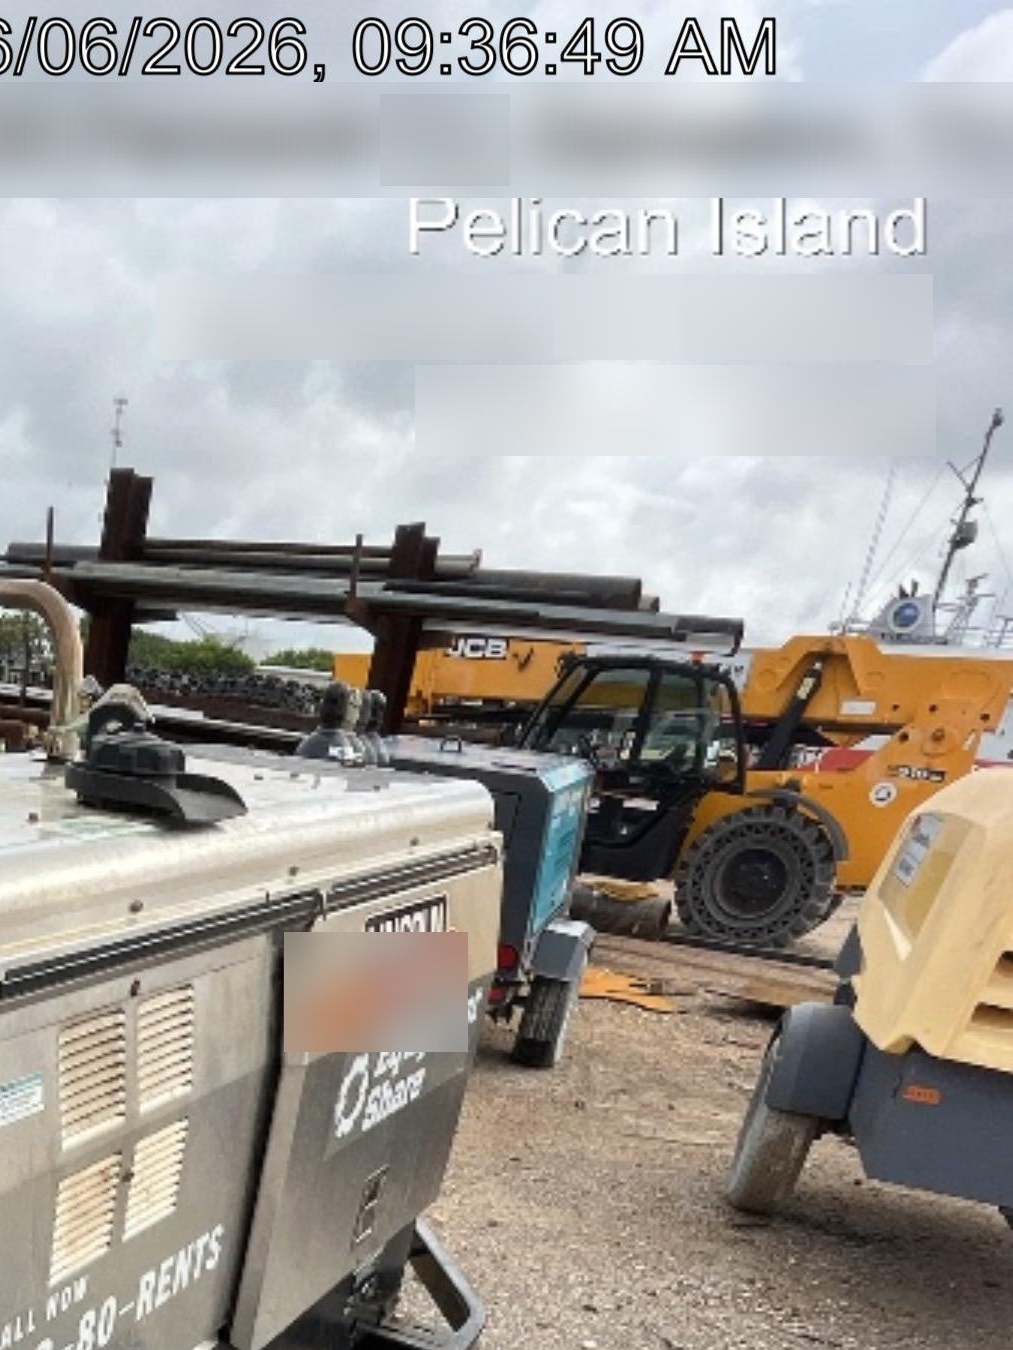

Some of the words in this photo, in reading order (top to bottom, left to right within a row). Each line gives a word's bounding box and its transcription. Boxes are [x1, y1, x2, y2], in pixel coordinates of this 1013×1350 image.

[447, 638, 508, 659] JCB
[361, 1067, 426, 1132] Share
[46, 1275, 89, 1321] NOW
